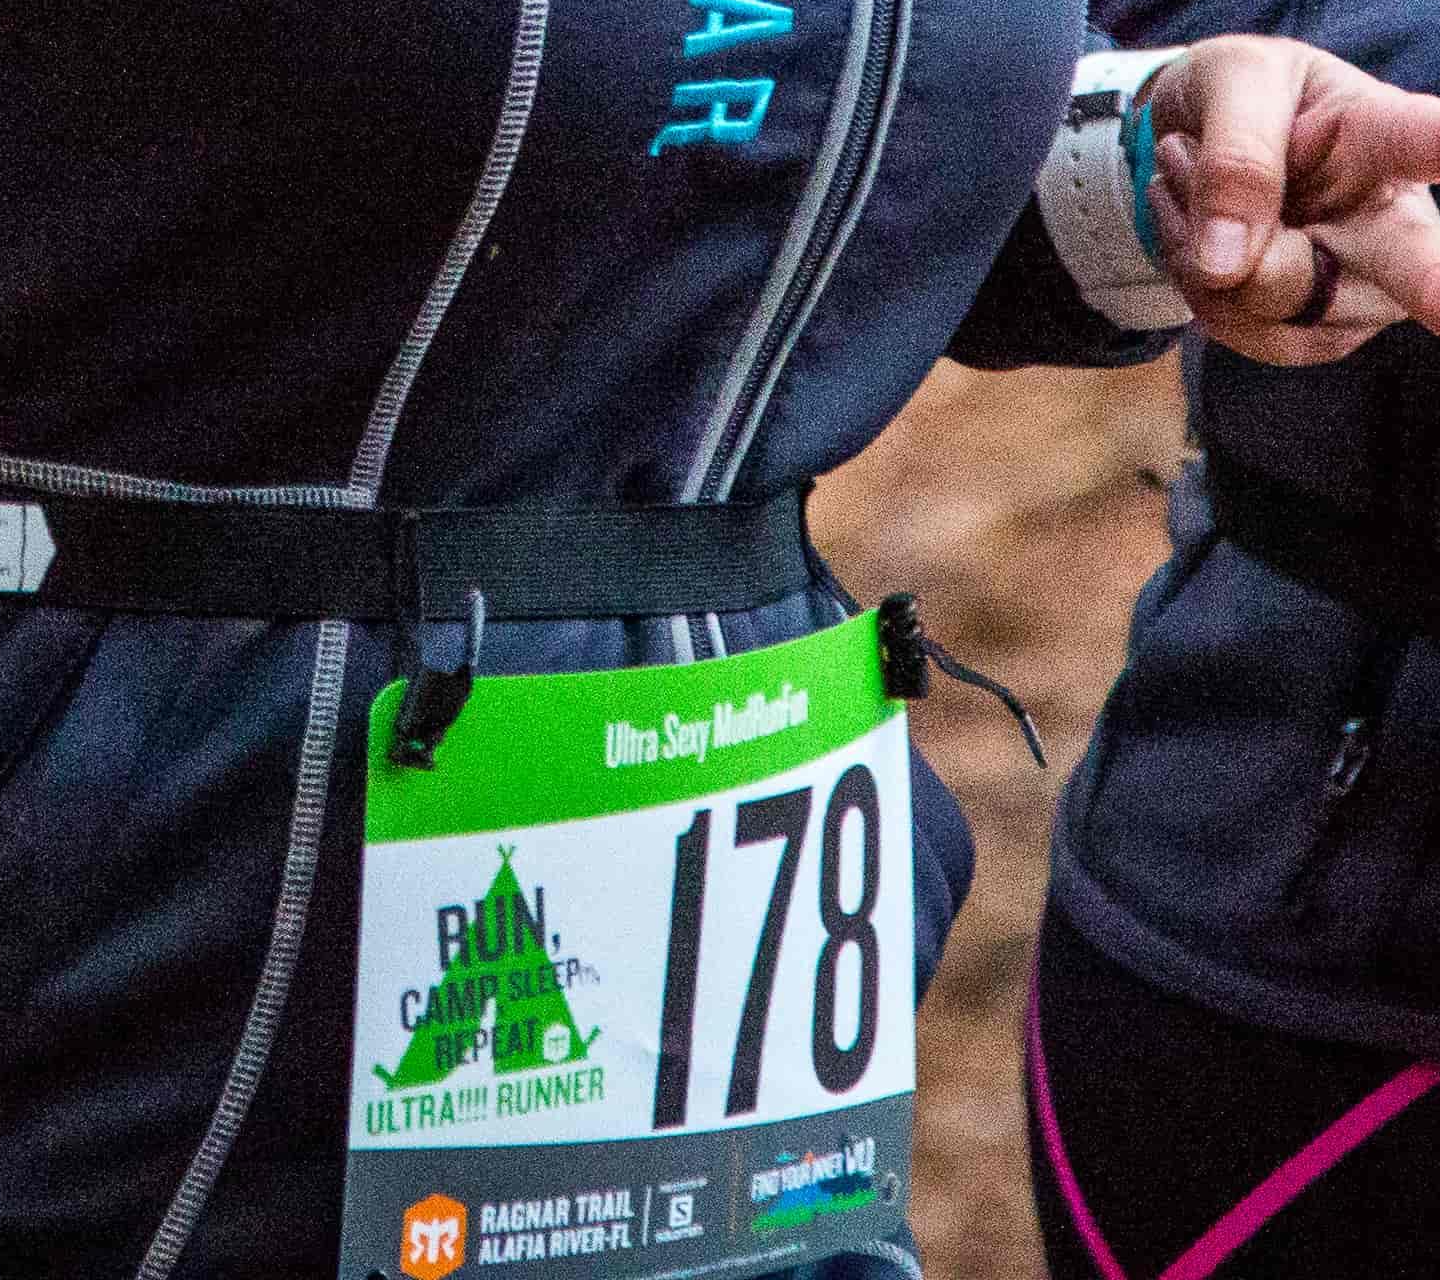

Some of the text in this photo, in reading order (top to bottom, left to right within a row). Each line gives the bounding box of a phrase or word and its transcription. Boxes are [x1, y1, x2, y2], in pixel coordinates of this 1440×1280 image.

[605, 720, 660, 768] Ultra
[661, 711, 711, 763] Sexy
[652, 764, 882, 1132] 178
[496, 1067, 606, 1118] RUNNER
[480, 1190, 635, 1234] RAGNAR TRAIL
[478, 1230, 547, 1264] ALAFIA
[548, 1222, 633, 1259] RIVER-FL
